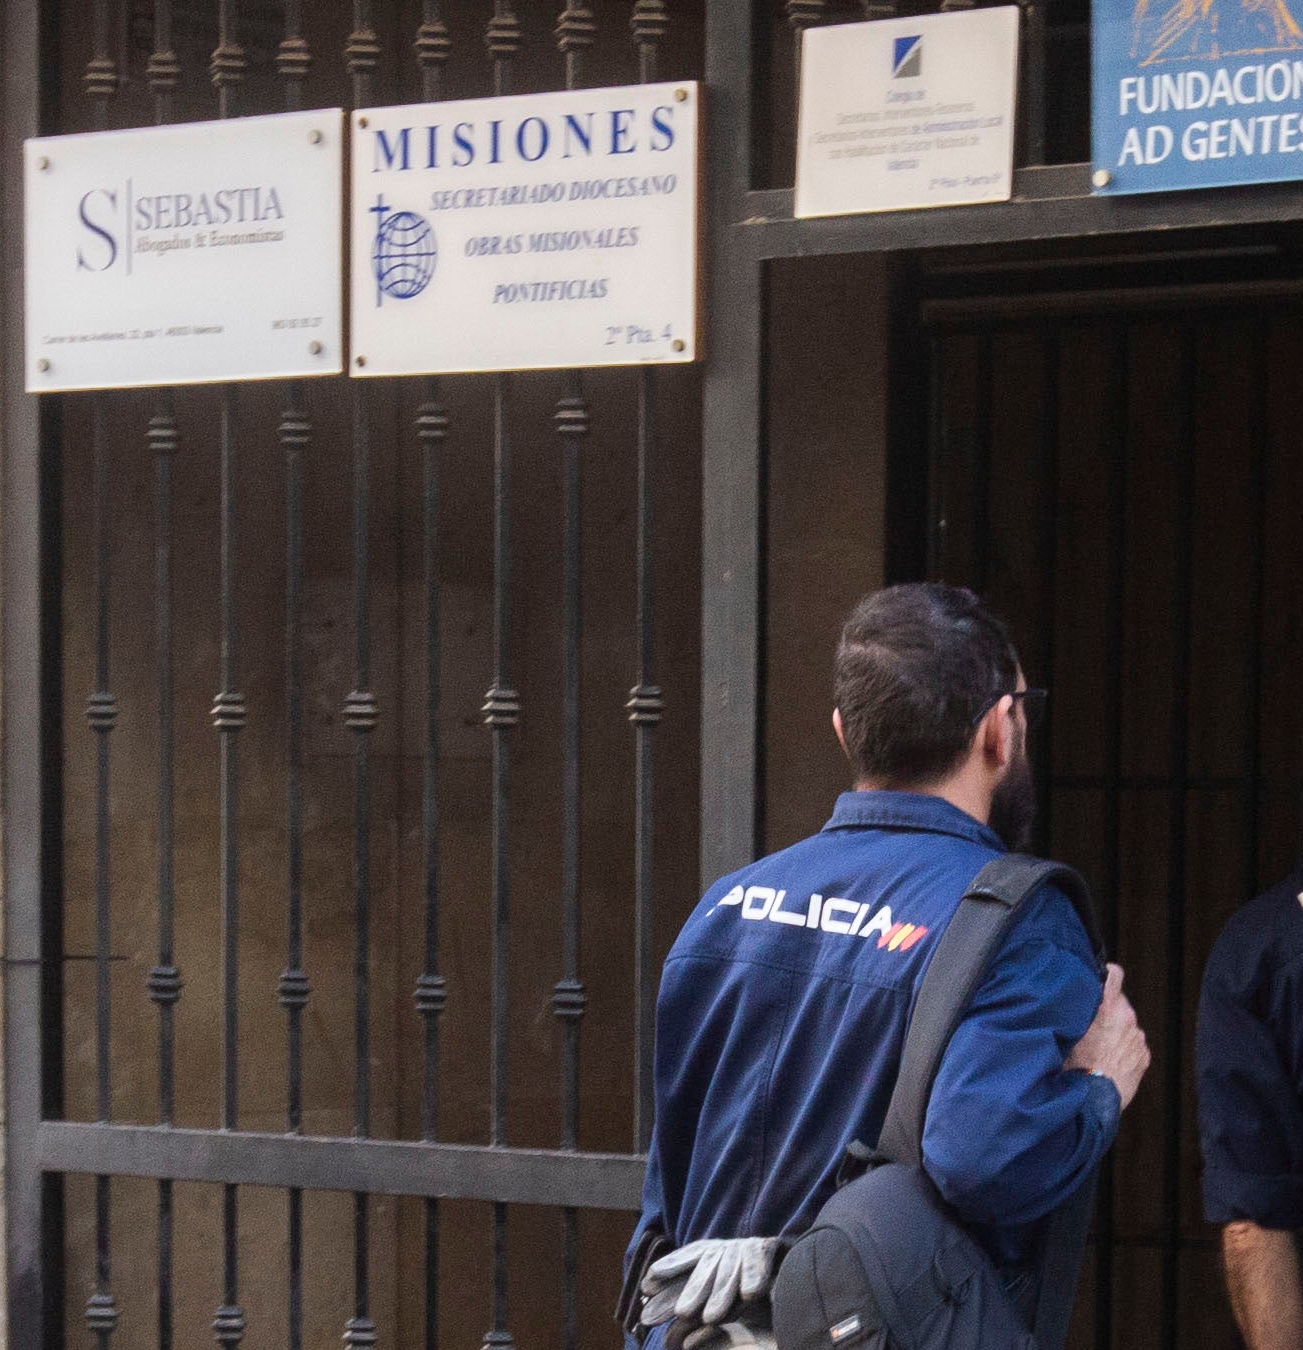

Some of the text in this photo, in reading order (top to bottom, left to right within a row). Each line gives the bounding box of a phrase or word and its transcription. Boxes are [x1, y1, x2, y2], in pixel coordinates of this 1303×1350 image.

[372, 105, 676, 173] MISIONES
[1117, 125, 1174, 166] AD
[430, 174, 677, 211] SECRETARIADO DIOCESANO
[76, 189, 117, 271] S
[464, 226, 640, 257] OBRAS MISIONALES
[492, 278, 609, 304] PONTIFICIAS
